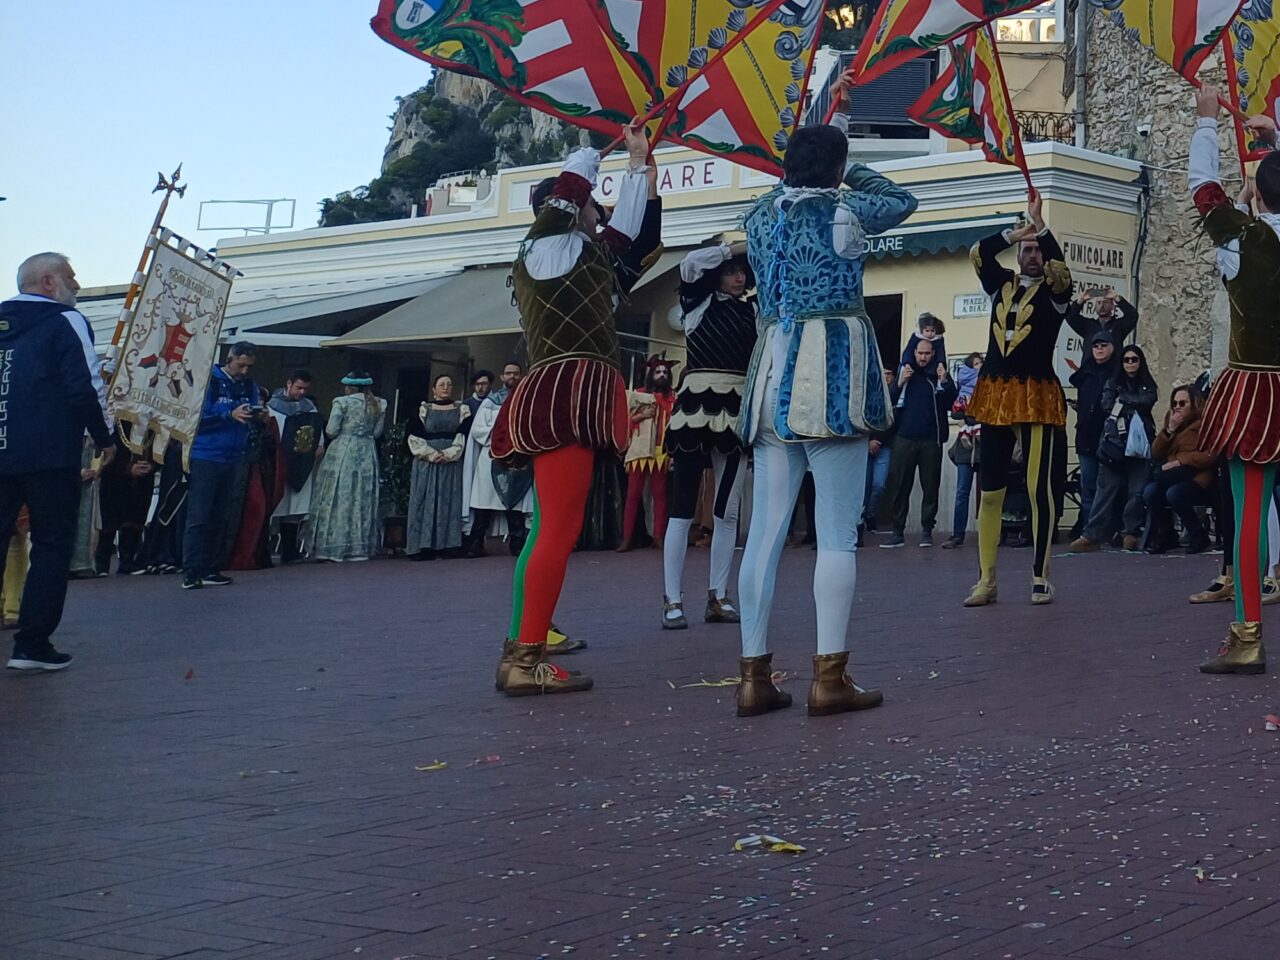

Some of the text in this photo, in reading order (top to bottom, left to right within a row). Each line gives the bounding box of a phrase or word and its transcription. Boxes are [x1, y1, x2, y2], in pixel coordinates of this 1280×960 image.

[862, 236, 904, 254] OLARE
[1063, 241, 1124, 269] FUNICOLARE
[963, 297, 987, 305] PIAZZA
[969, 304, 988, 313] DIAZ
[1, 348, 15, 396] CAVA
